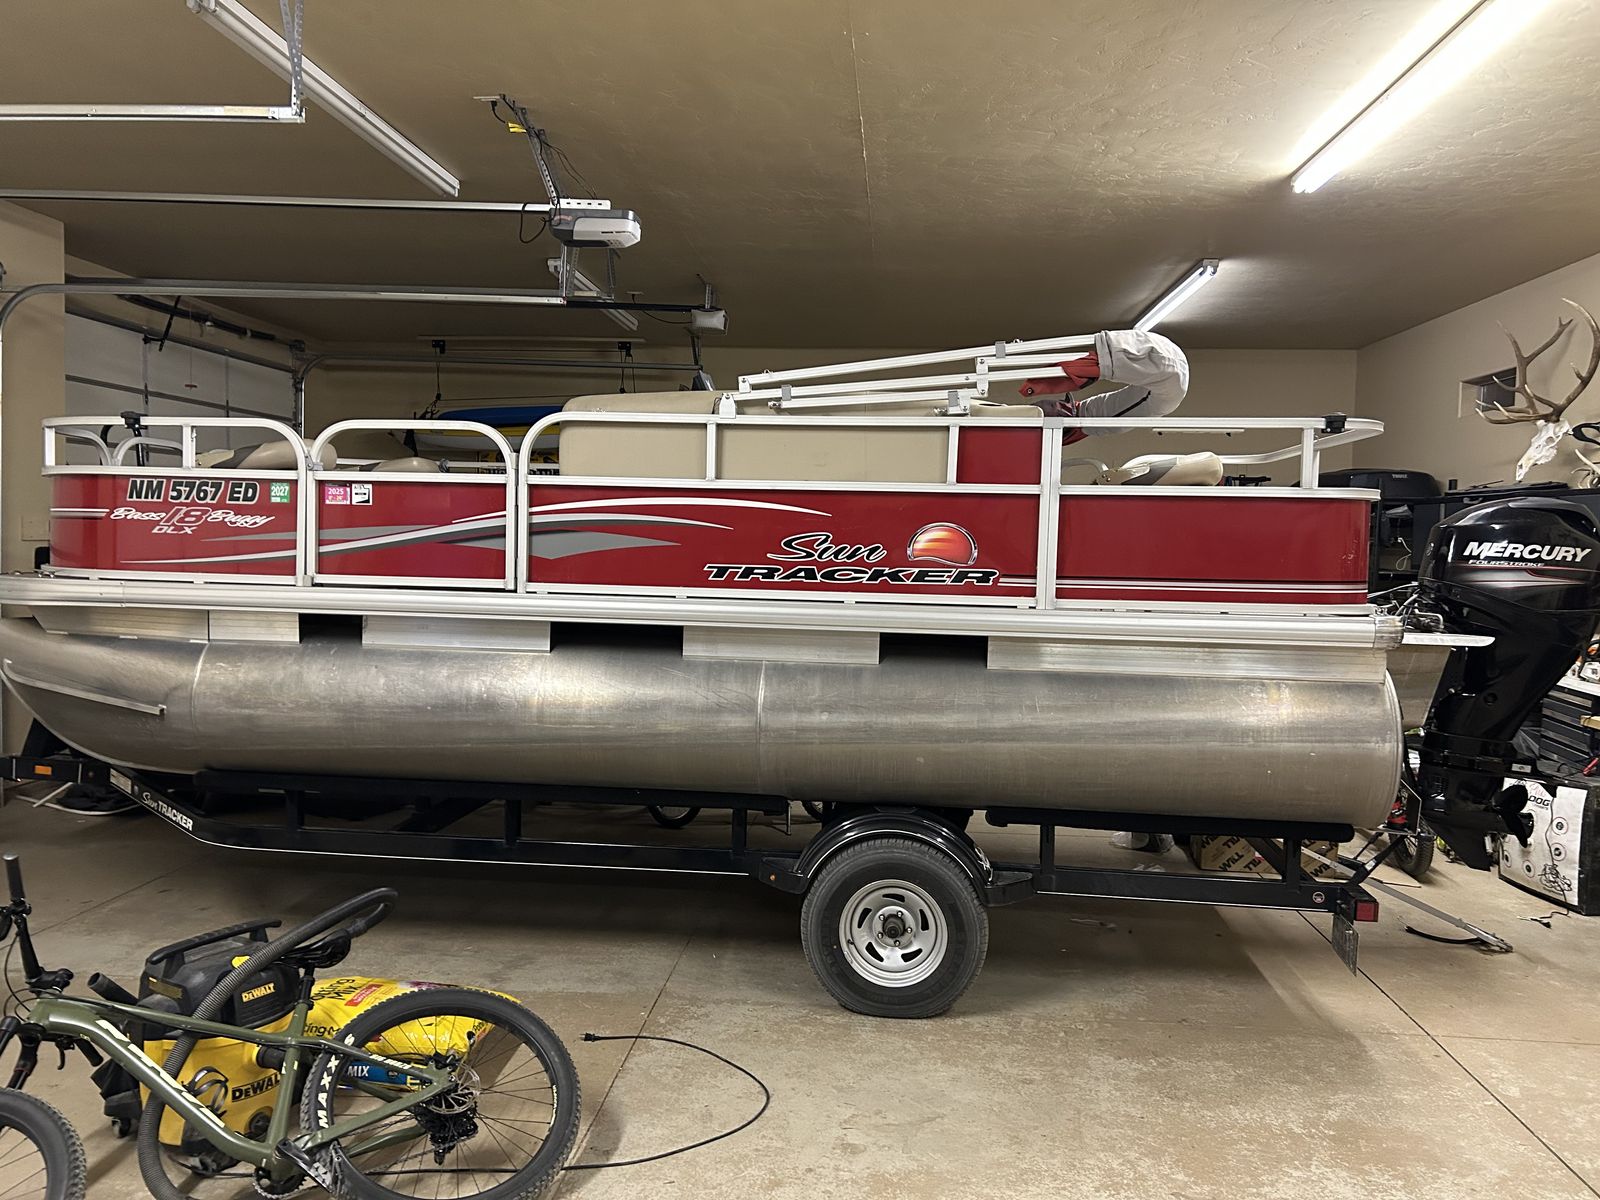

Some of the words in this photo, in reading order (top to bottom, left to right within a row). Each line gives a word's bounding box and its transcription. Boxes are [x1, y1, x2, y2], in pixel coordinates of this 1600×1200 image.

[127, 478, 166, 502] NM
[168, 479, 224, 503] 5767
[226, 481, 260, 505] ED
[271, 485, 289, 497] 2027
[328, 487, 344, 497] 2025
[110, 507, 167, 521] Bass
[160, 506, 212, 526] 18
[206, 509, 276, 528] Buggy
[152, 525, 197, 534] DLX
[767, 532, 887, 562] Sun
[1462, 540, 1592, 563] MERCURY
[1468, 559, 1546, 568] FOURSTROKE
[703, 563, 999, 586] TRACKER
[142, 792, 158, 810] Sun
[158, 800, 194, 831] TRACKER
[1218, 851, 1245, 872] WILL
[241, 983, 276, 1002] DEWALT
[310, 979, 356, 1000] otting
[317, 1033, 355, 1128] MAXXS
[347, 1065, 370, 1077] MIX
[232, 1073, 280, 1102] DEWAL
